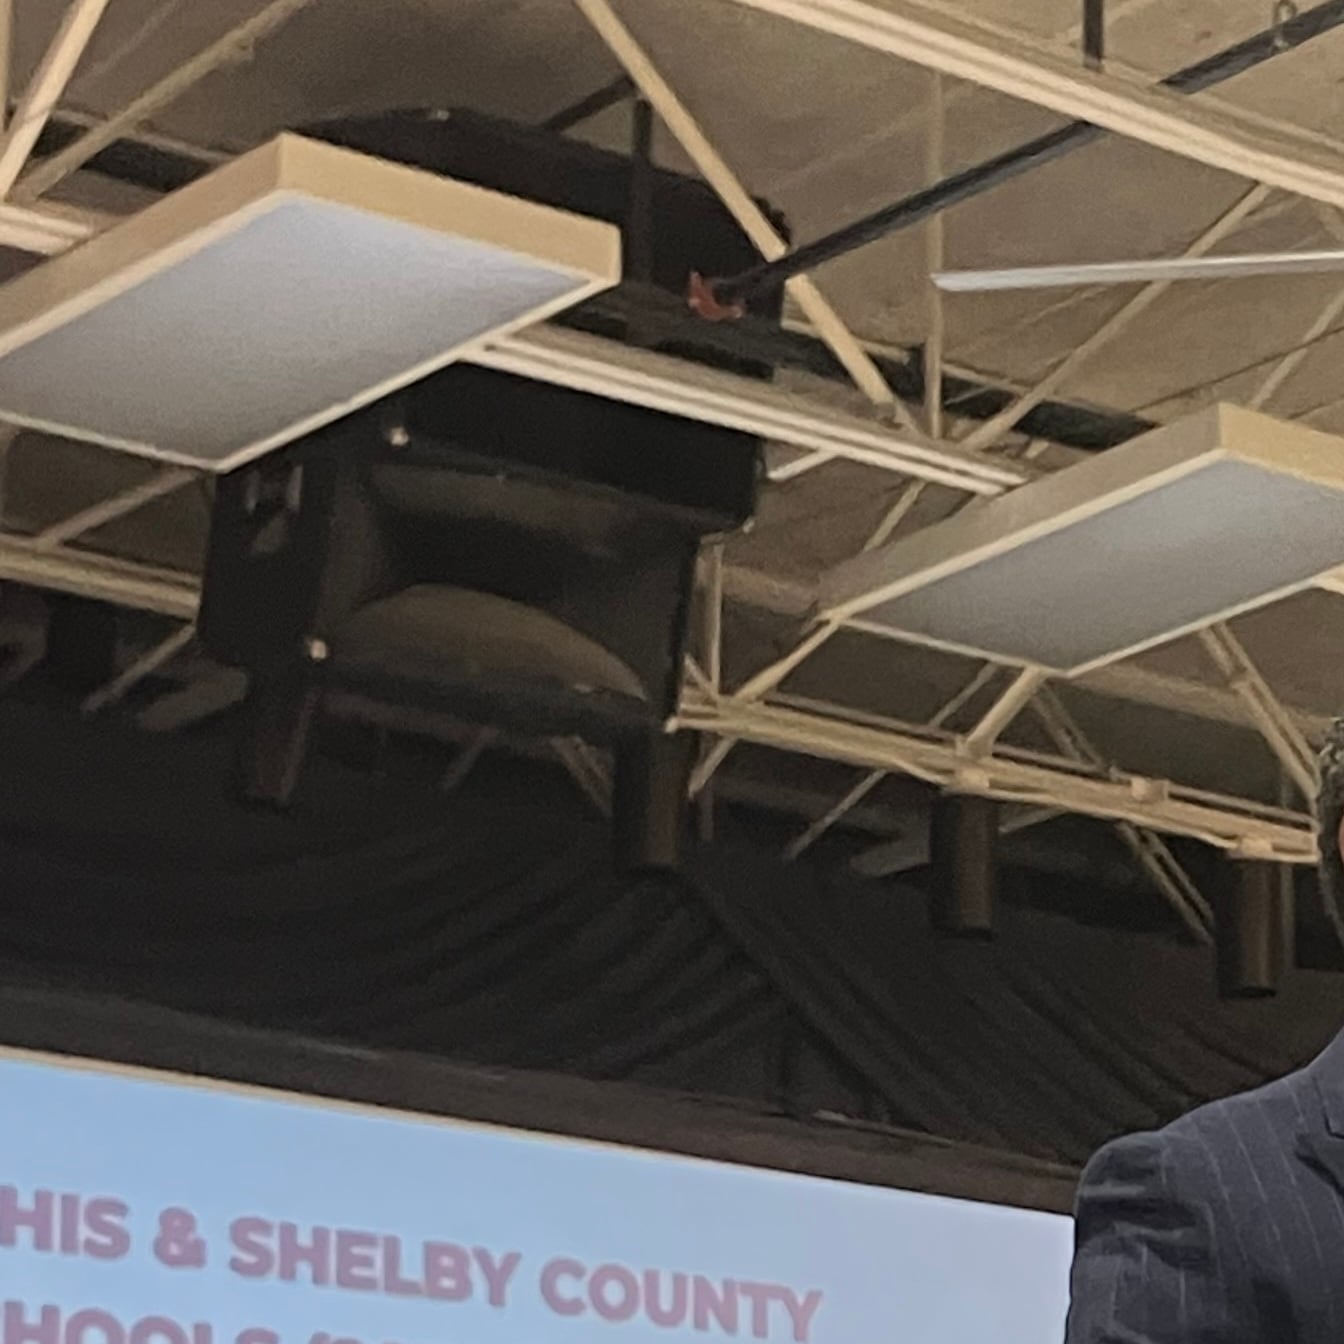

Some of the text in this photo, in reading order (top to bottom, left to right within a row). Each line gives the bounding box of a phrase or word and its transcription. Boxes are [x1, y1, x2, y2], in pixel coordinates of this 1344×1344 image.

[153, 1206, 207, 1269] &
[228, 1216, 523, 1308] SHELBY
[539, 1258, 824, 1343] COUNTY
